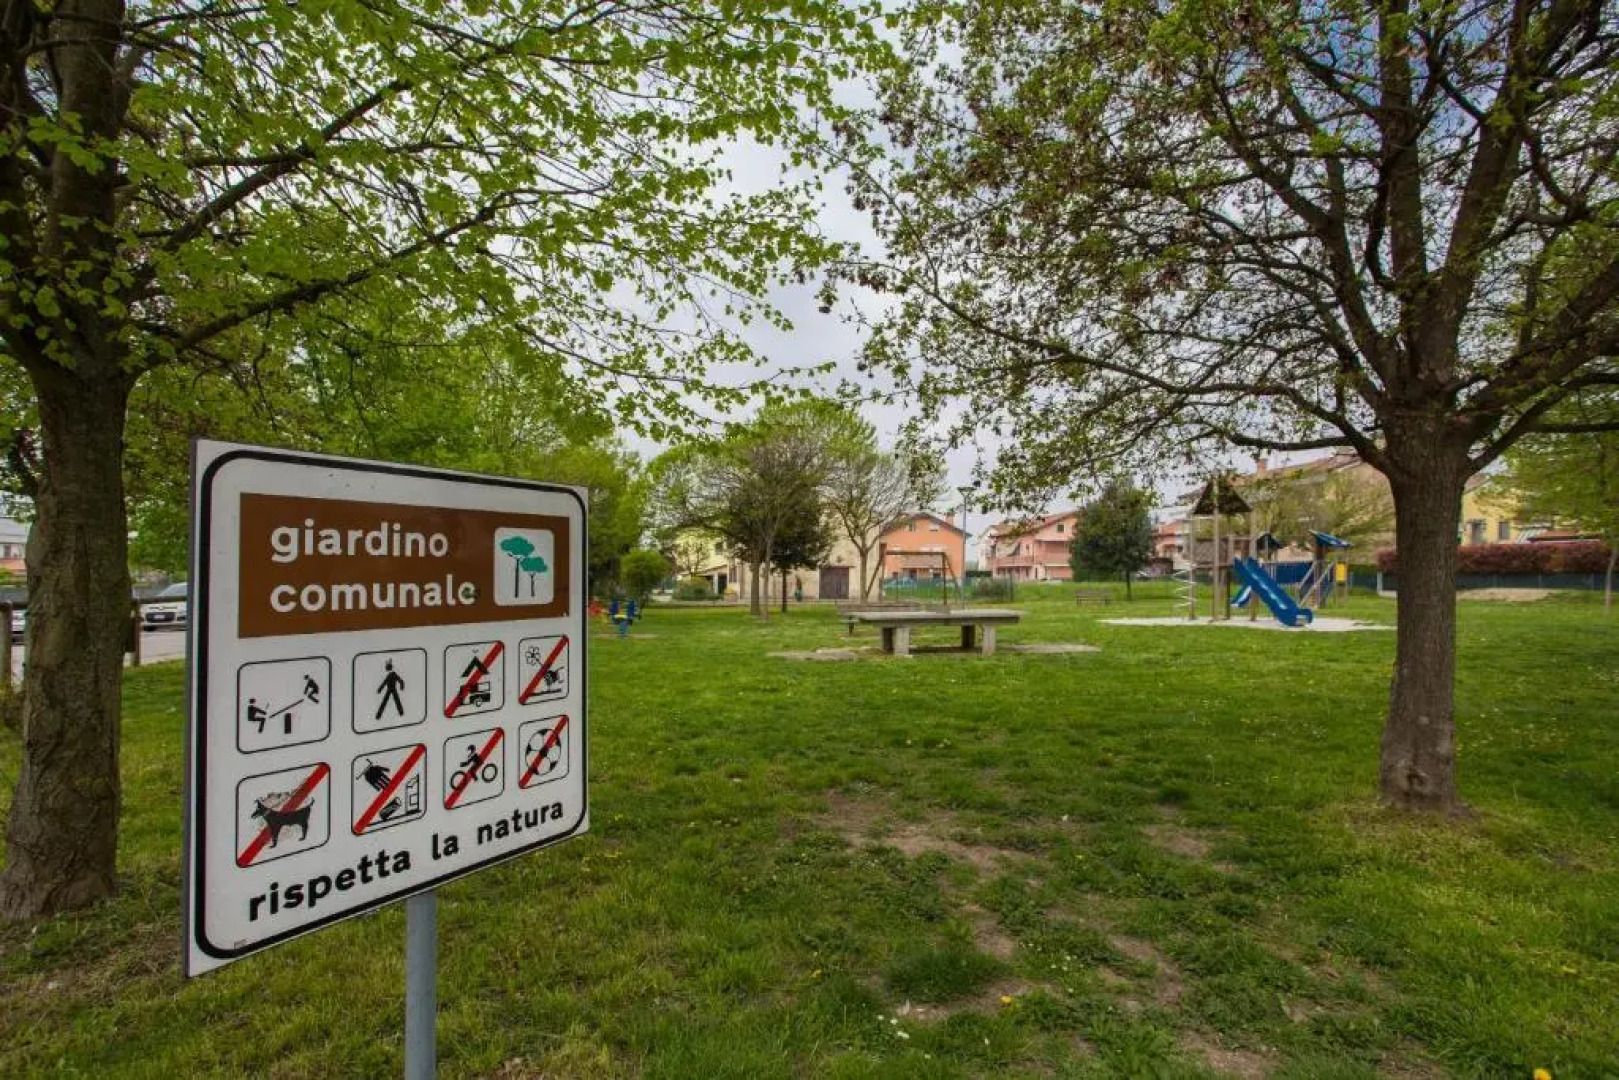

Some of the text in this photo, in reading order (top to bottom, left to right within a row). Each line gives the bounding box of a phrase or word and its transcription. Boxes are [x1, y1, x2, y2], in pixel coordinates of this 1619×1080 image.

[270, 518, 449, 563] giardino
[269, 573, 477, 613] comunale
[248, 801, 564, 922] rispetta la natura
